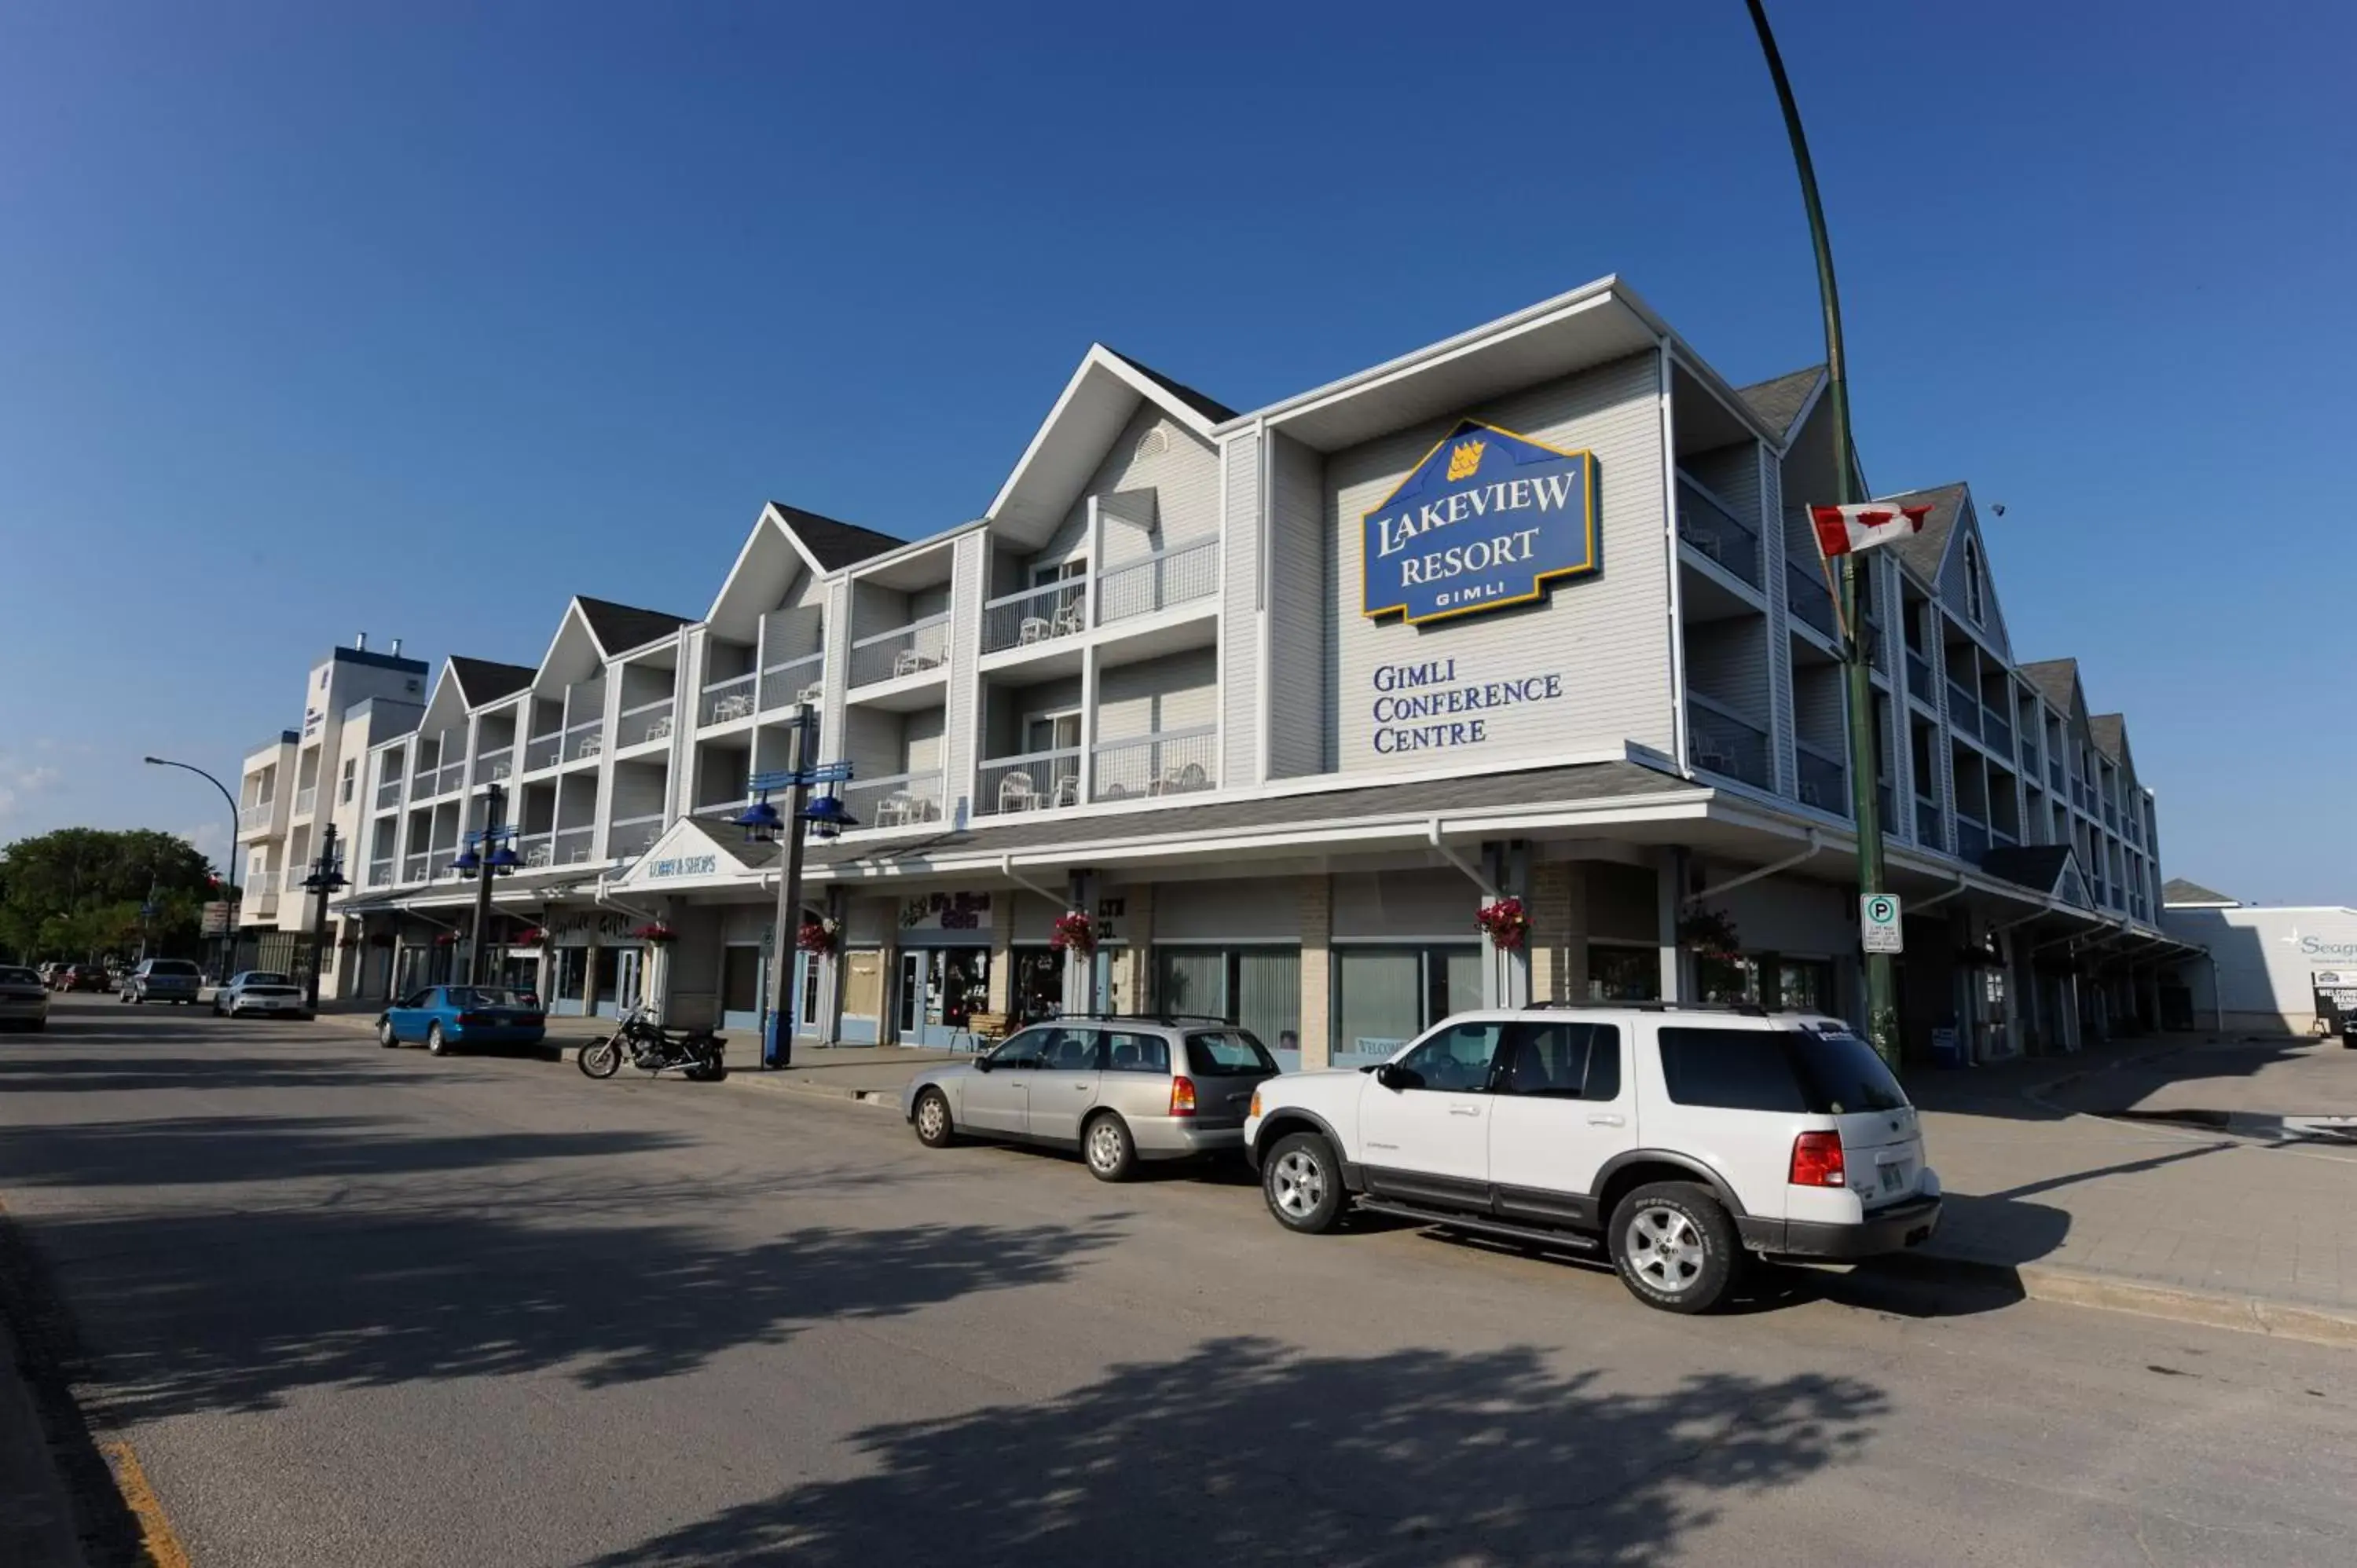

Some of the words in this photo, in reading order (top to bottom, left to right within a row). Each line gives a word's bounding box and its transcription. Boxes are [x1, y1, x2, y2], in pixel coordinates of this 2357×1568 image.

[1377, 471, 1576, 558] LAKEVIEW
[1401, 528, 1540, 588] RESORT
[1436, 581, 1505, 606] GIMLI
[1373, 659, 1456, 692] GIMLI
[1373, 674, 1563, 723] CONFERENCE
[1373, 720, 1486, 754] CENTRE
[684, 854, 716, 874] SHOPS
[1875, 903, 1888, 918] P
